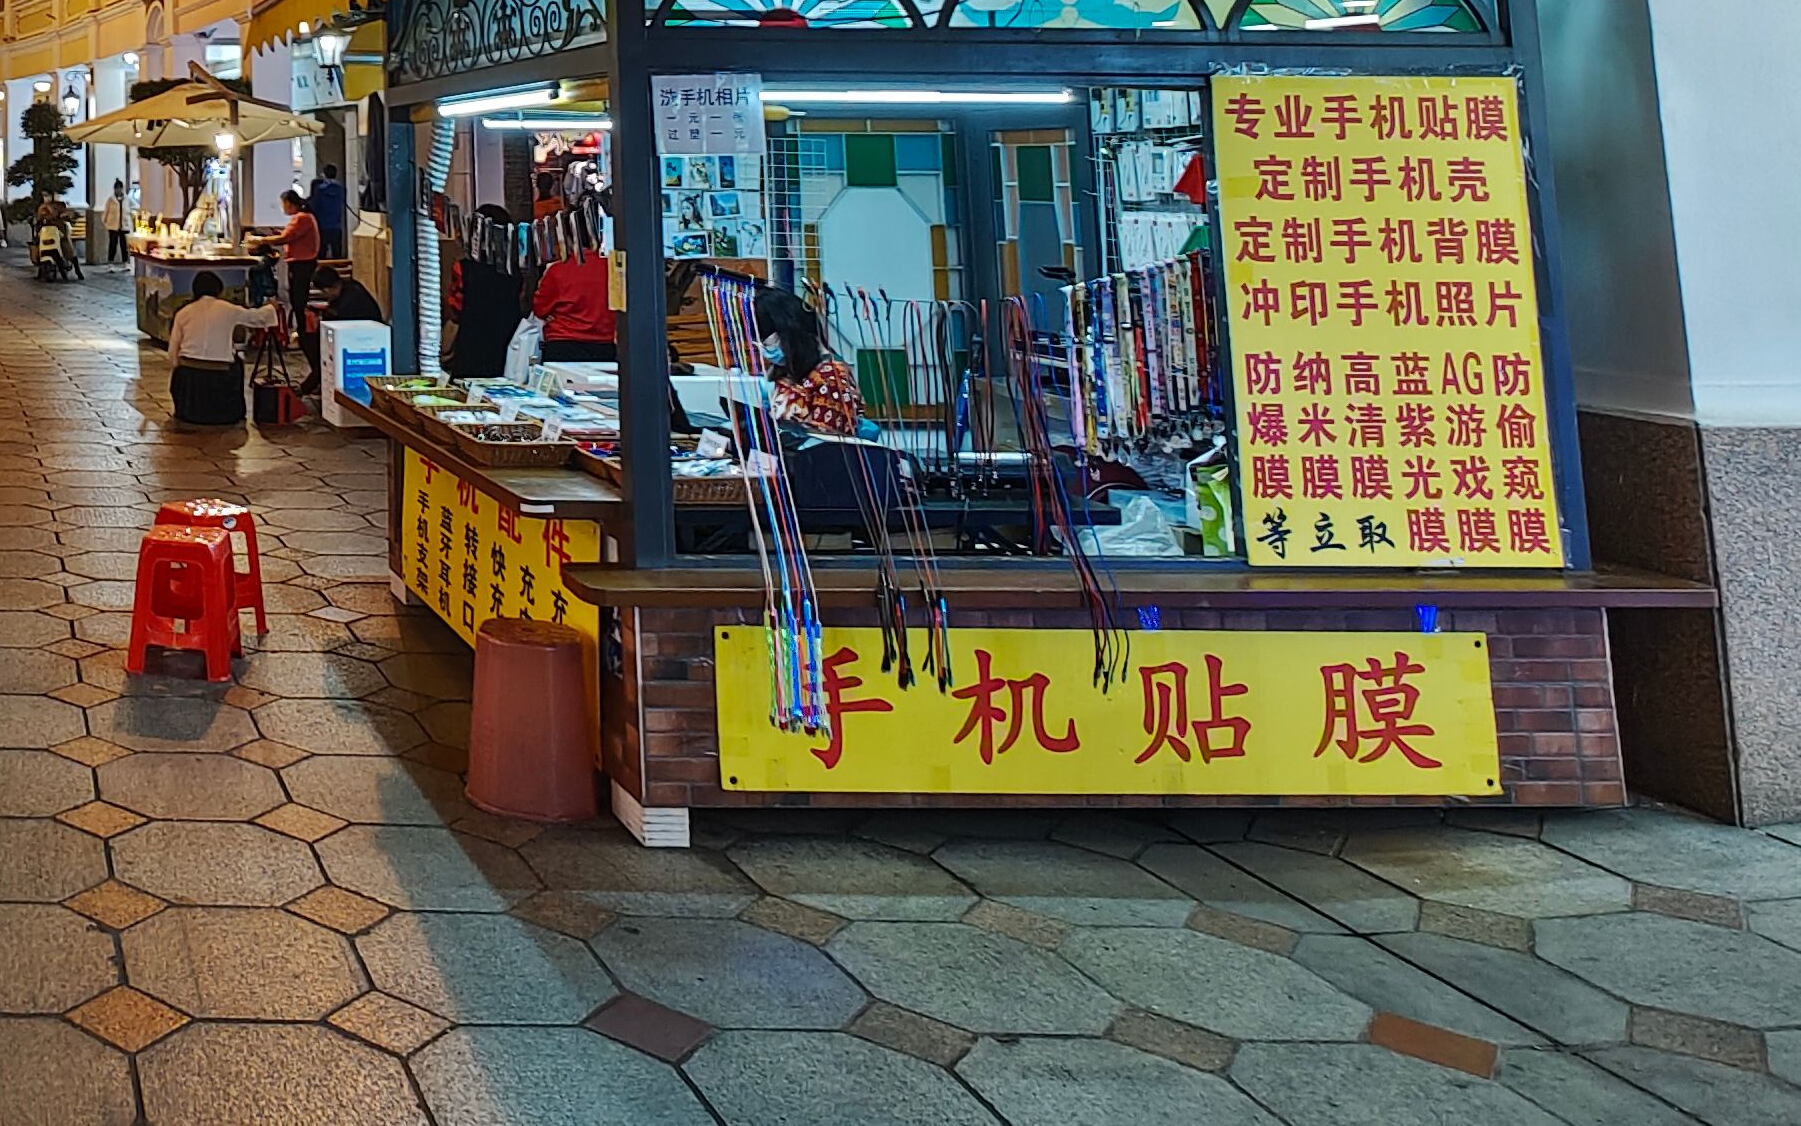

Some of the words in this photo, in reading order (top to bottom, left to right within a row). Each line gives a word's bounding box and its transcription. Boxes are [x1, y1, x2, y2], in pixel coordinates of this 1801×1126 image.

[660, 88, 750, 107] 洗手机相片
[1224, 93, 1510, 142] 专业手机贴膜
[1253, 155, 1491, 203] 定制手机壳
[1234, 216, 1521, 266] 定制手机背膜
[1240, 279, 1524, 329] 冲印手机照片
[416, 489, 430, 596] 手机支架
[1256, 507, 1396, 559] 等立取
[439, 504, 454, 618] 蓝牙耳机
[462, 523, 479, 634] 转接口
[800, 646, 1444, 769] 手机贴膜
